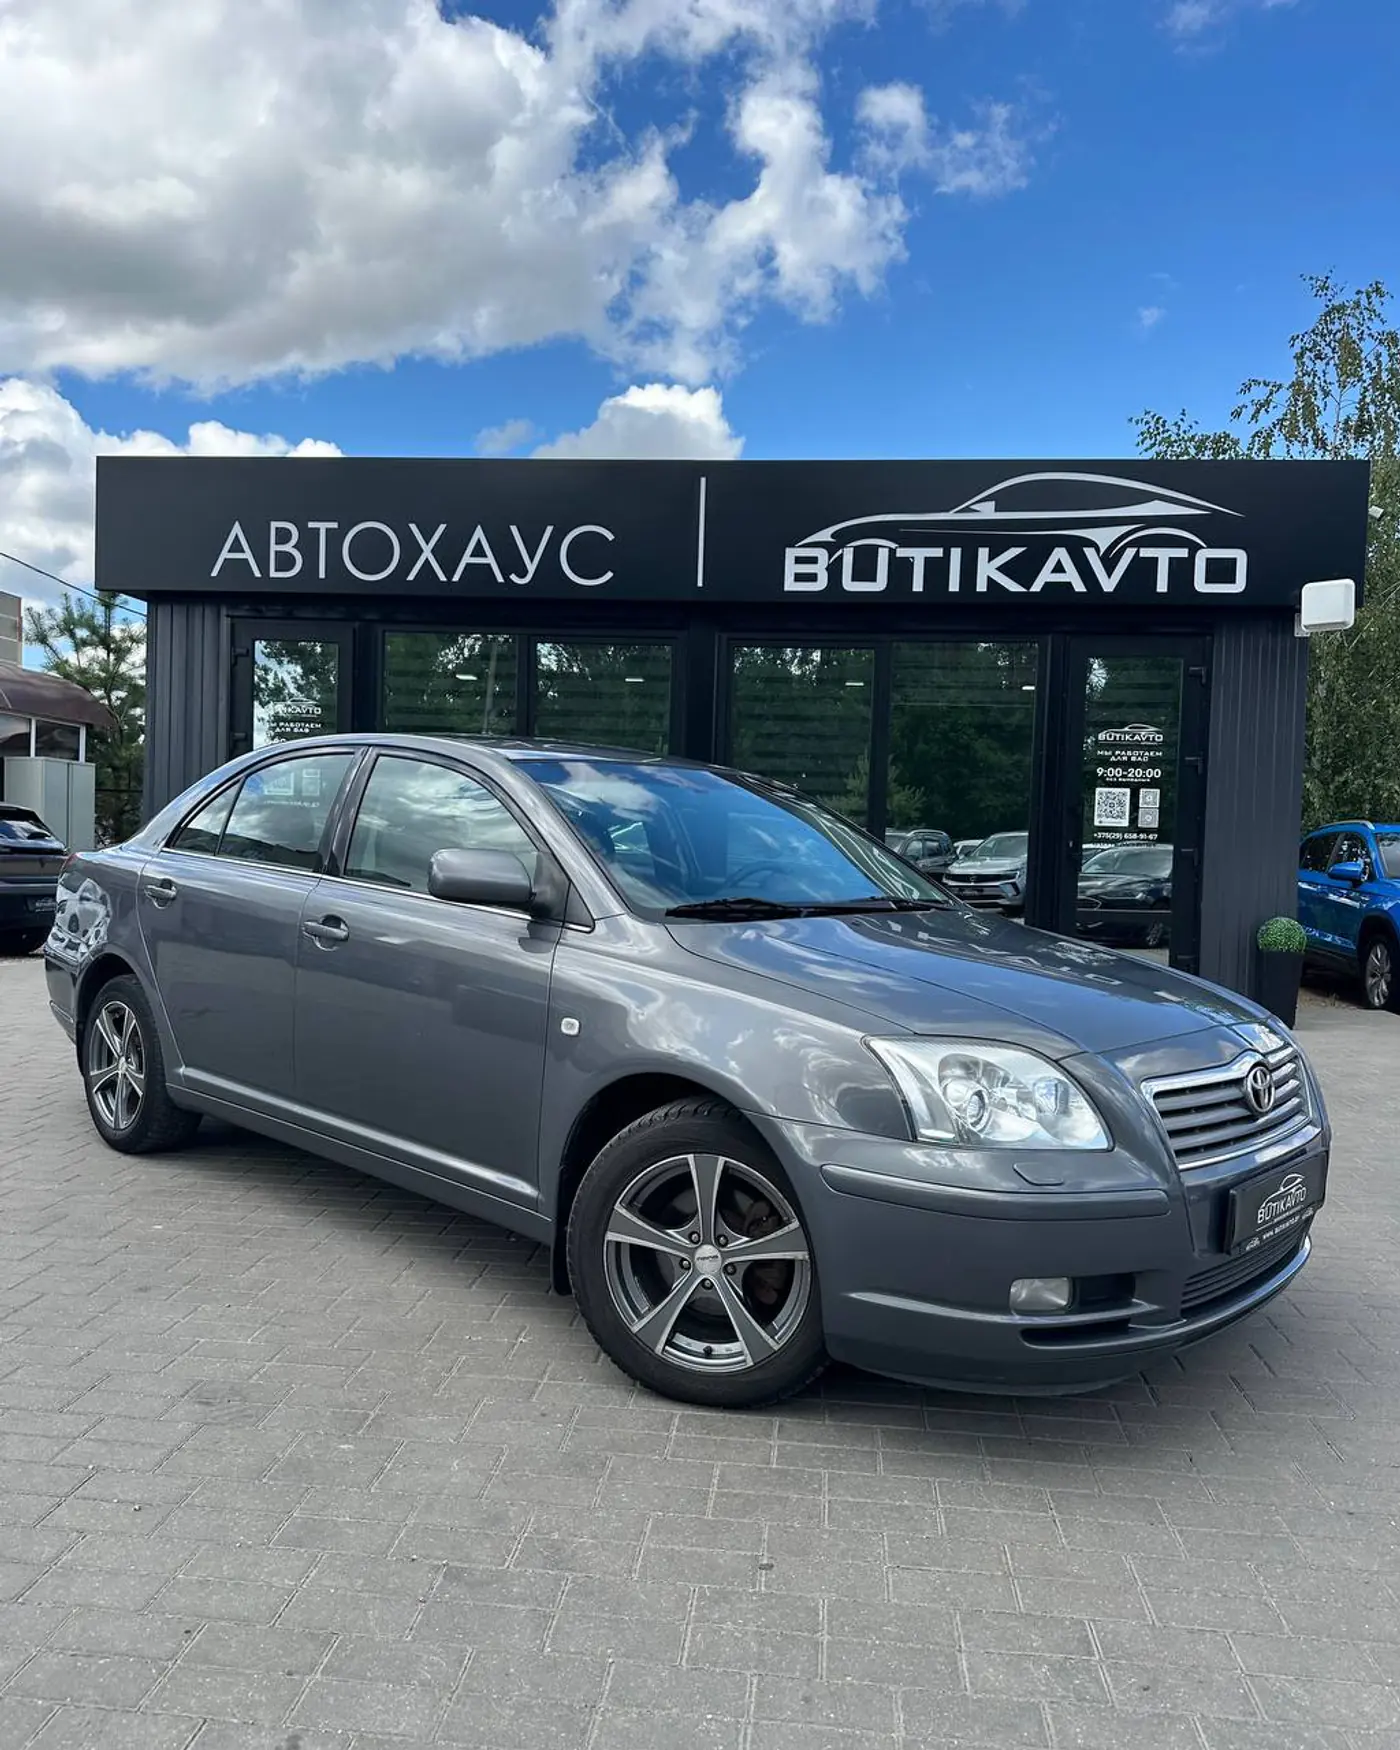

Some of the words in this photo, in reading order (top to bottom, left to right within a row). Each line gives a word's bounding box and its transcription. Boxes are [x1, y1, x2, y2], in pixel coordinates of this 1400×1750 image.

[210, 520, 615, 585] АВТОХАУС
[783, 546, 1248, 594] BUTIKAVTO
[1098, 732, 1164, 742] BUTIKAVTO
[1096, 767, 1162, 778] 9:00-20:00
[1257, 1186, 1307, 1224] BUTIKAVTO
